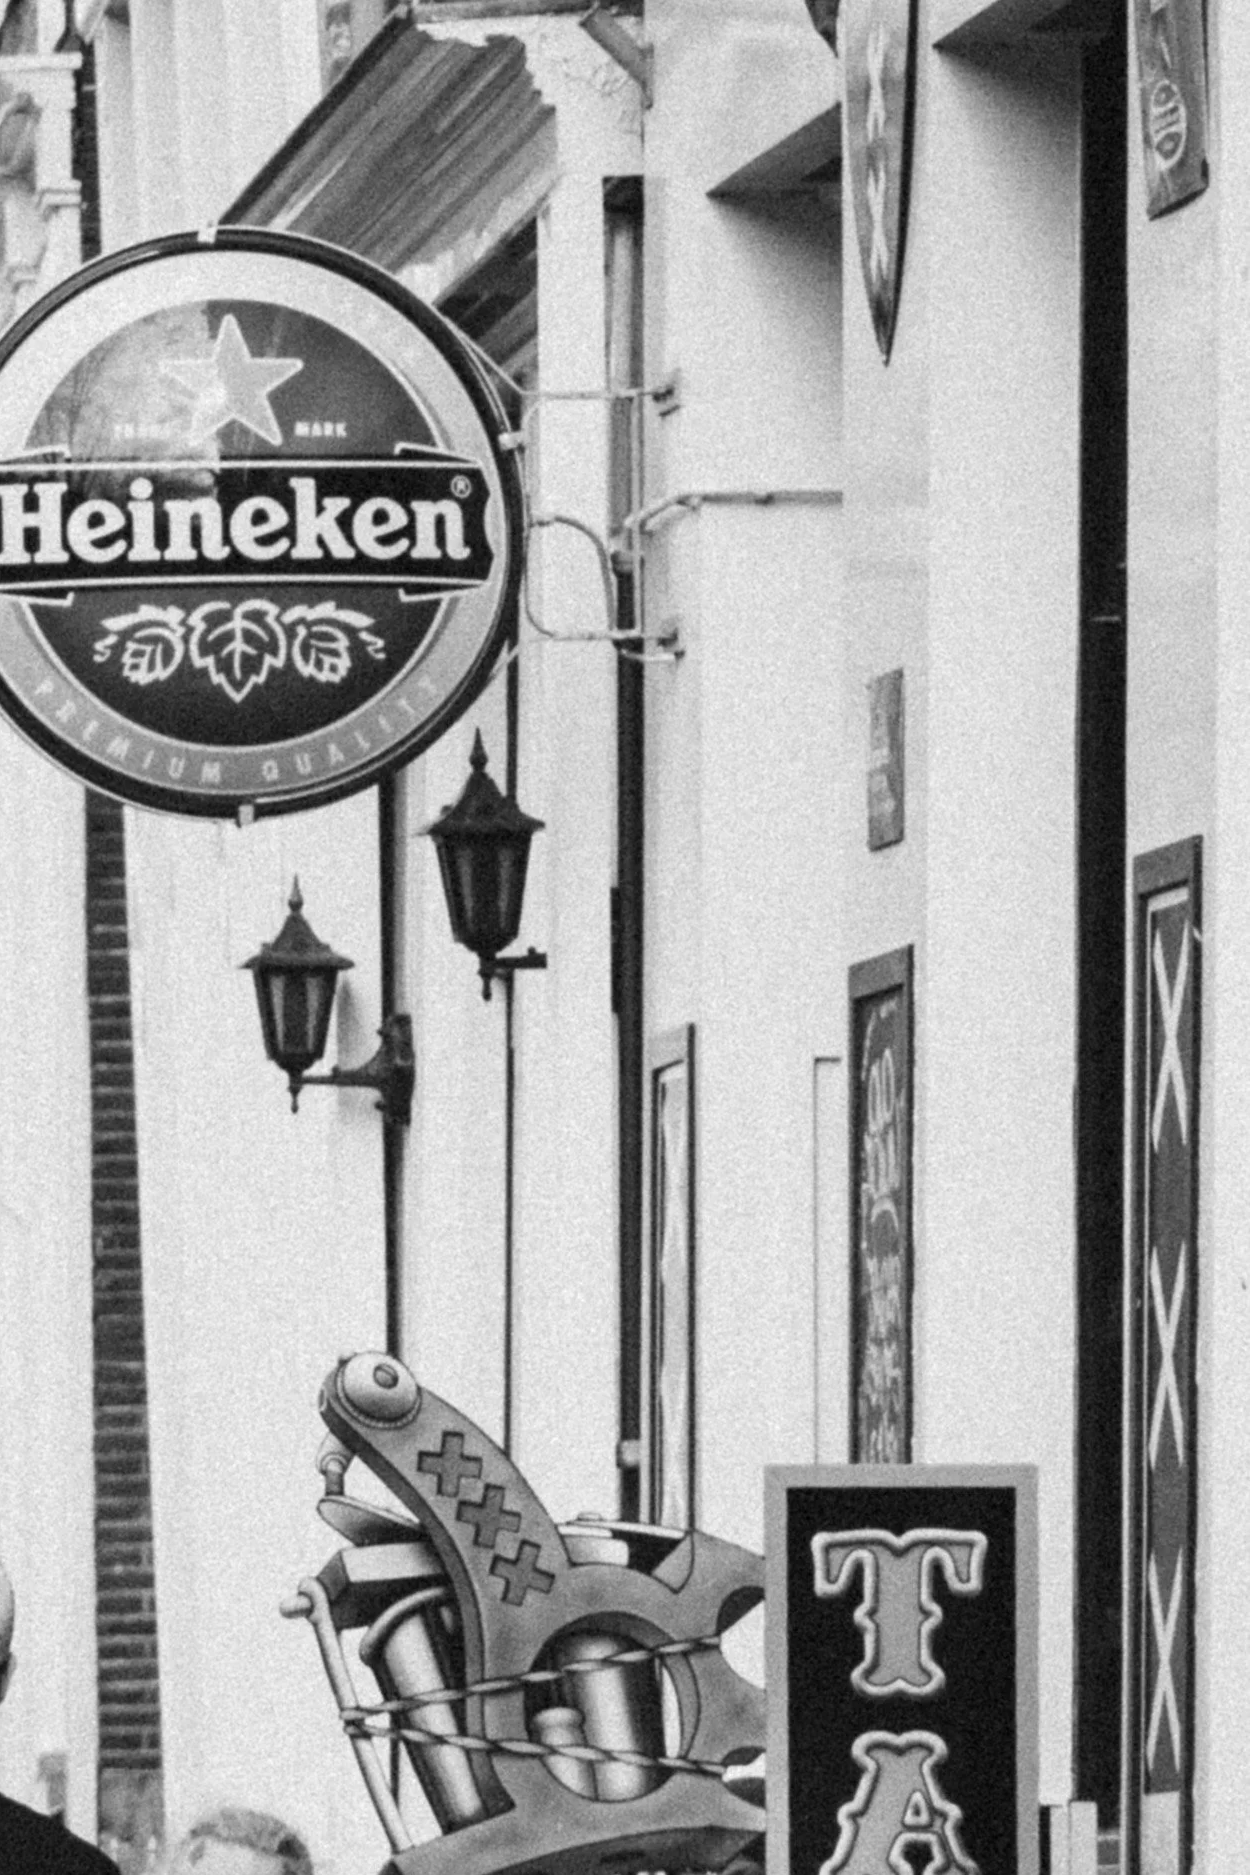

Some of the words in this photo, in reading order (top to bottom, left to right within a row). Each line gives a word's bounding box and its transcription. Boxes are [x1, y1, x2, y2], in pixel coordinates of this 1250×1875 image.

[294, 420, 347, 438] MARK
[34, 678, 222, 785] PREMIUM
[261, 673, 438, 783] QUALITY
